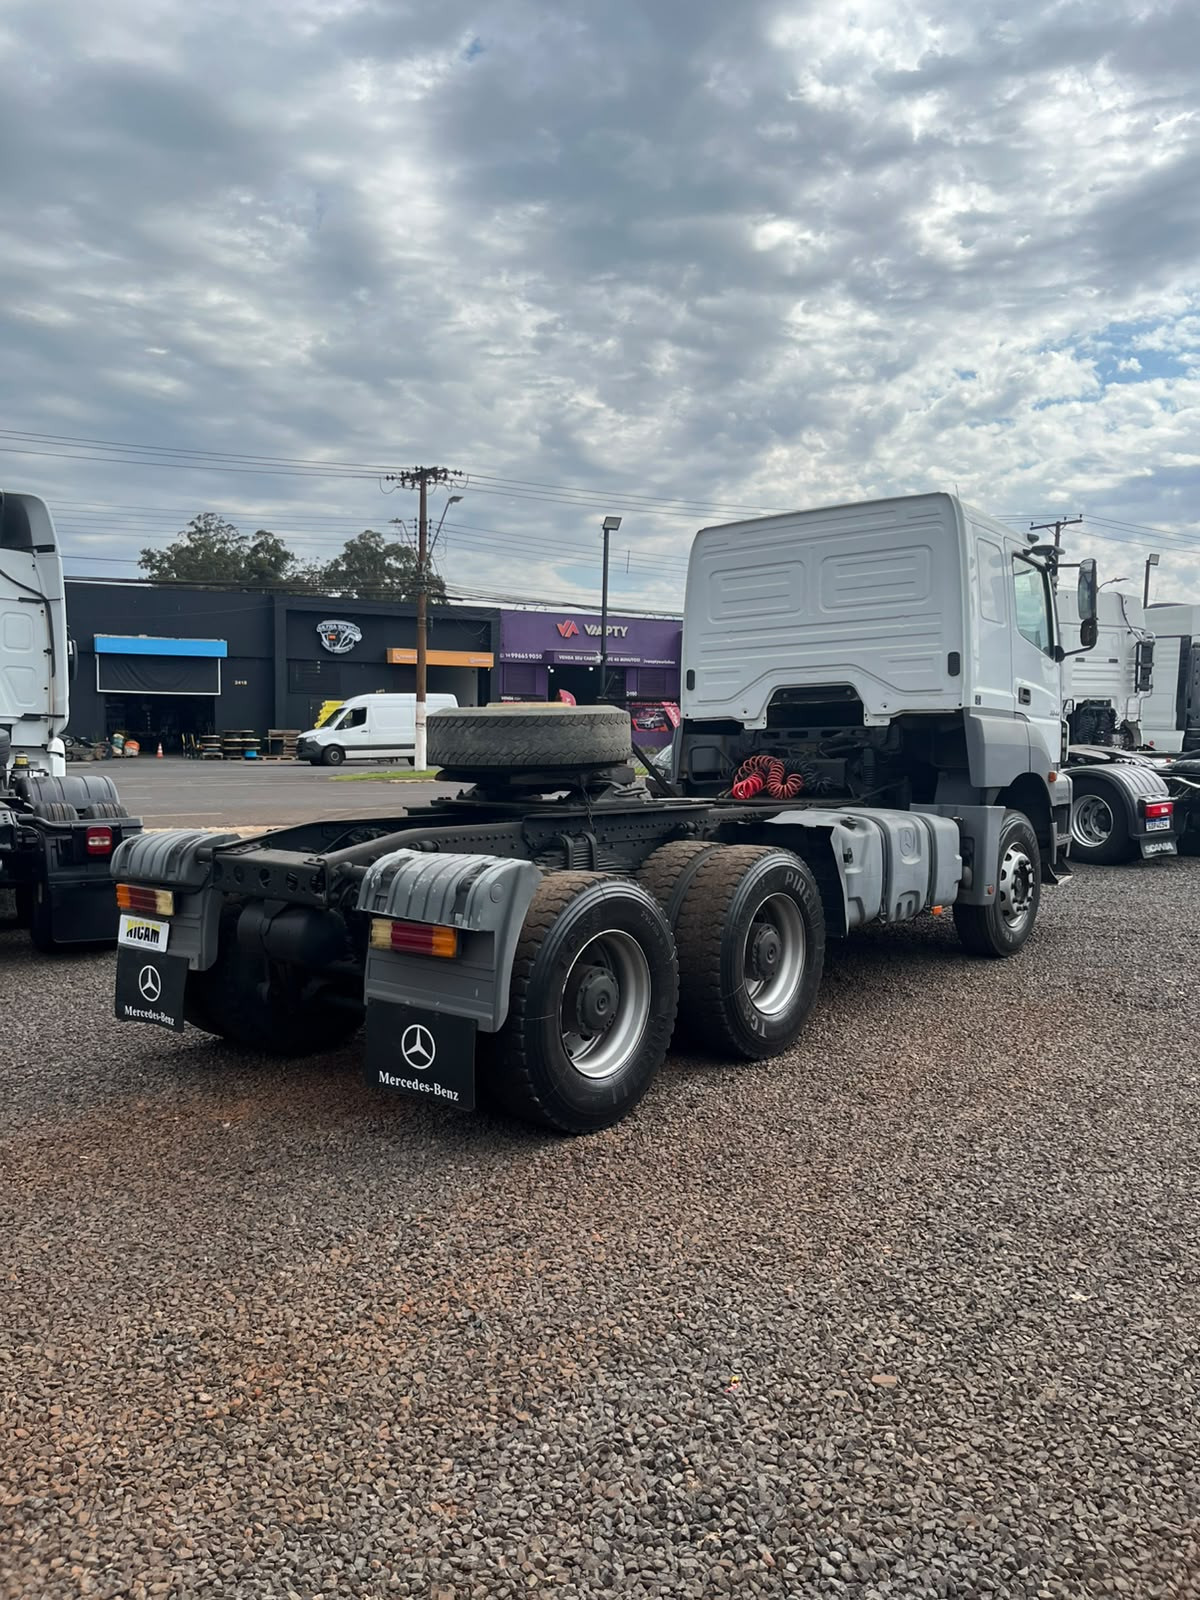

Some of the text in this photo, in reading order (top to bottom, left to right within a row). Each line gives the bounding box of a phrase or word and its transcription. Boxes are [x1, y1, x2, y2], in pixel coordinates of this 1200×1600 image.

[1144, 841, 1174, 854] SCANIA
[124, 1004, 175, 1026] Mercedes-Benz
[378, 1070, 460, 1101] Mercedes-Benz
